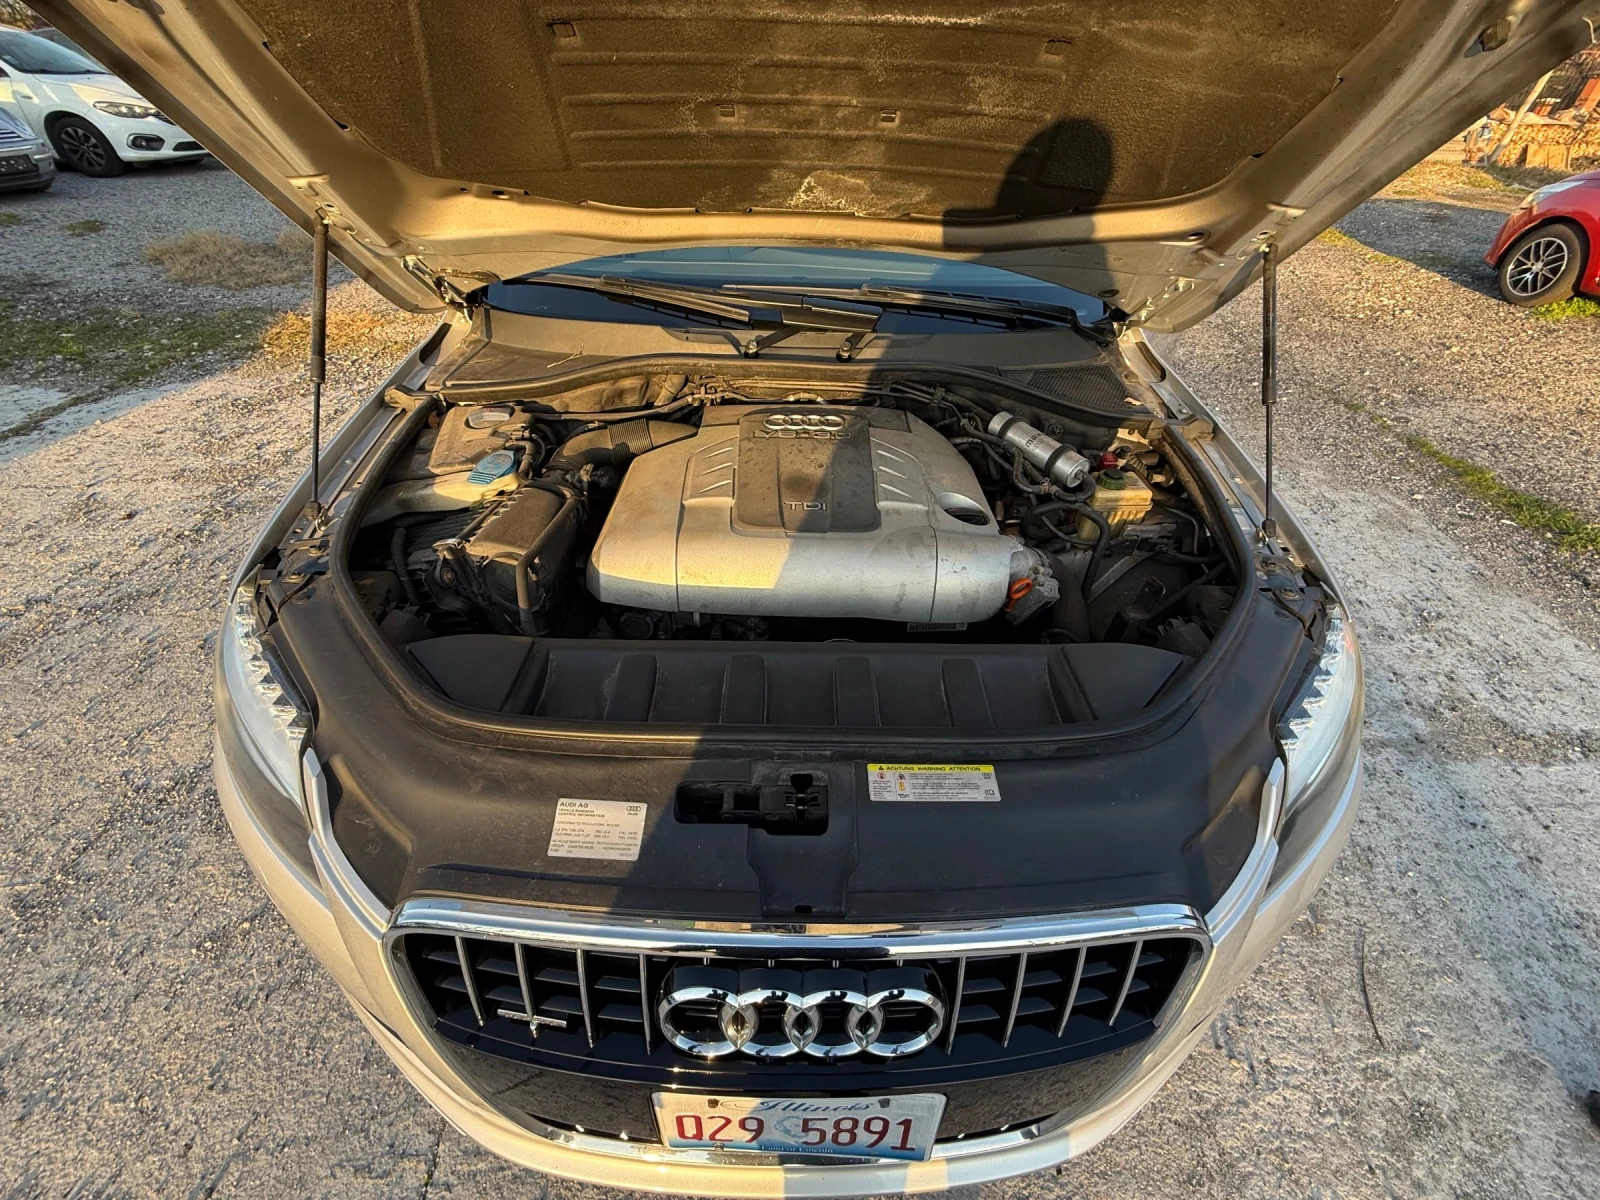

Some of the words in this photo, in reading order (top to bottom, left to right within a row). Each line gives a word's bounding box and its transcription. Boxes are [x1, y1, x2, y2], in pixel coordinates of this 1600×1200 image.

[784, 501, 827, 511] TDI
[748, 1098, 874, 1112] Illinois
[675, 1114, 765, 1143] Q29
[800, 1116, 917, 1151] 5891
